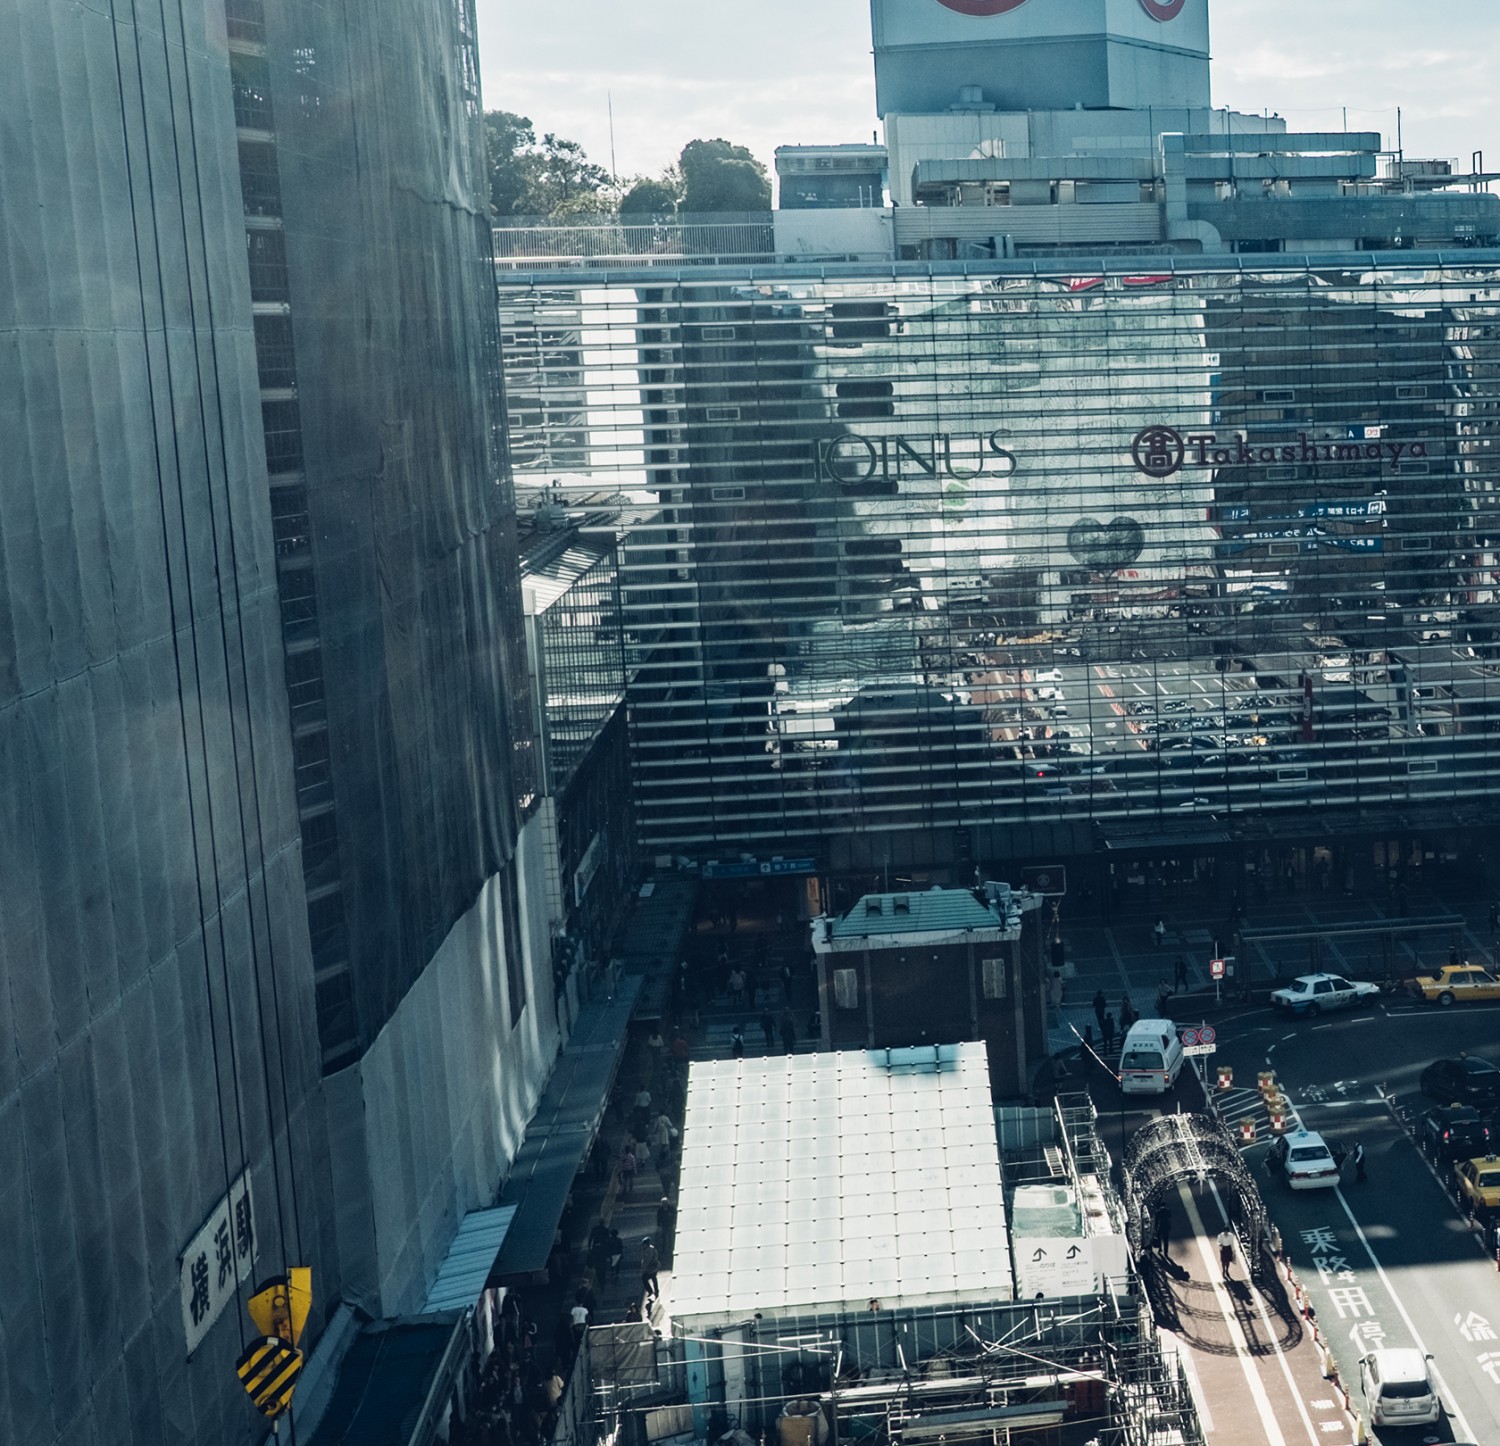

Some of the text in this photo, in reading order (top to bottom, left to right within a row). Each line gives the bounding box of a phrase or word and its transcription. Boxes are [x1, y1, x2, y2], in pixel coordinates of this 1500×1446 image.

[1188, 431, 1428, 469] Takashimaya
[190, 1191, 252, 1327] 横浜駅
